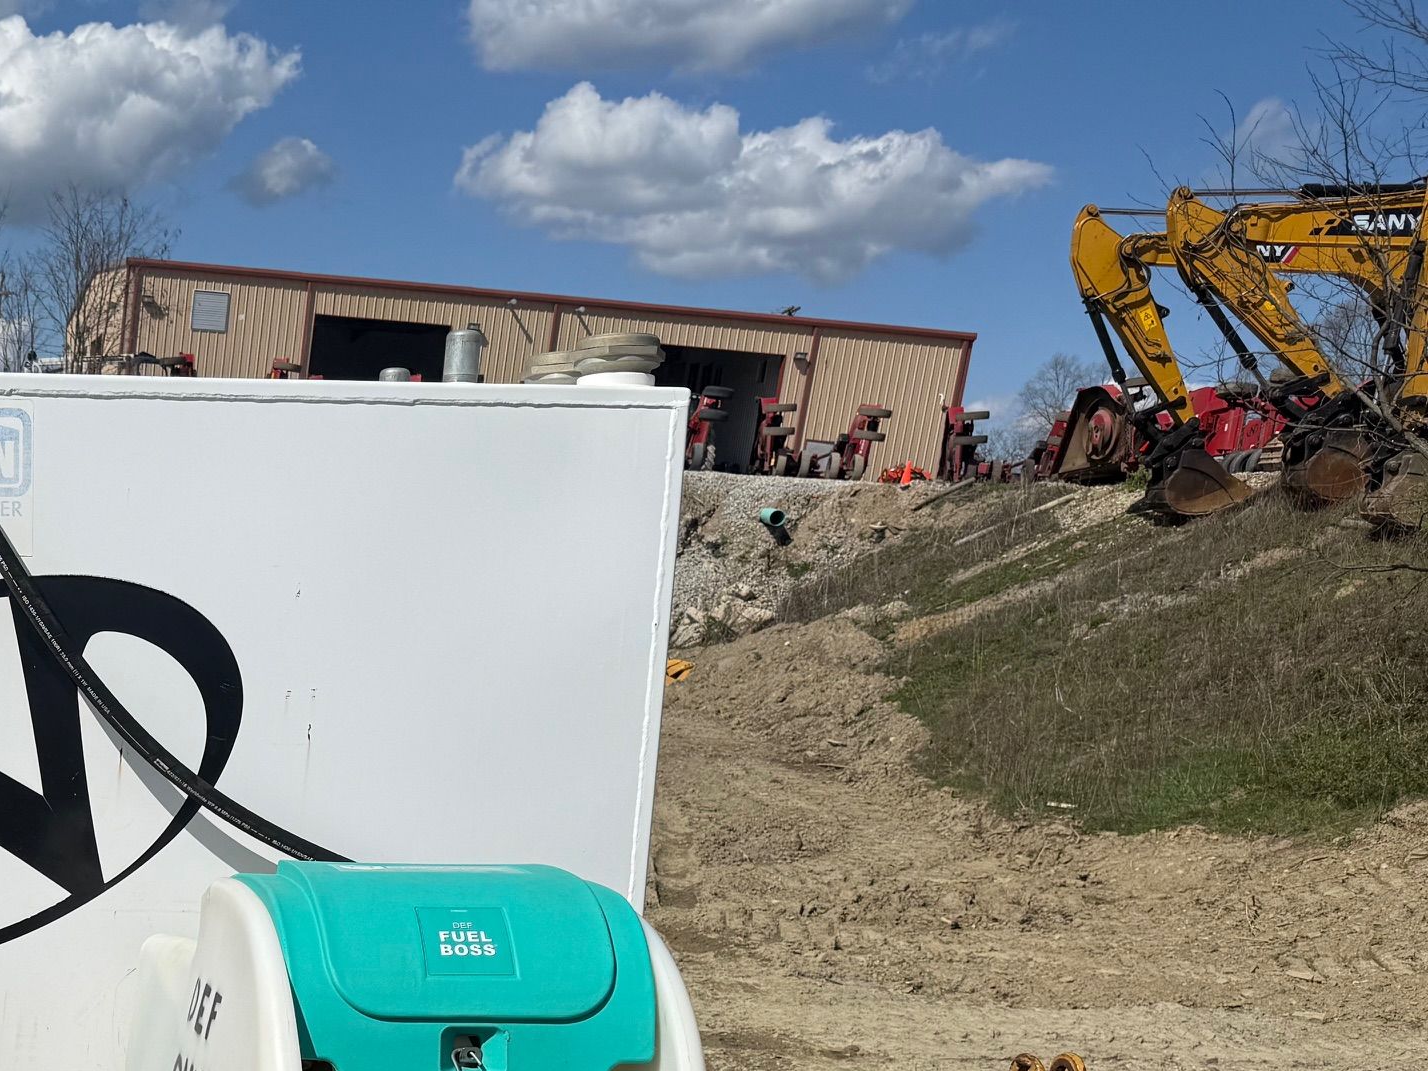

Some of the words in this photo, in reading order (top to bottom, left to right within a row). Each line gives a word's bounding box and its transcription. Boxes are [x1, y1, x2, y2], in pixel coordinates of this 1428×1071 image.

[1351, 212, 1422, 231] SANY
[1256, 245, 1286, 257] NY
[19, 593, 30, 605] ISO
[84, 685, 99, 701] MADE
[99, 702, 111, 715] USA
[452, 921, 473, 929] DEF
[438, 930, 493, 942] FUEL
[439, 943, 497, 956] BOSS
[186, 976, 223, 1042] DEF
